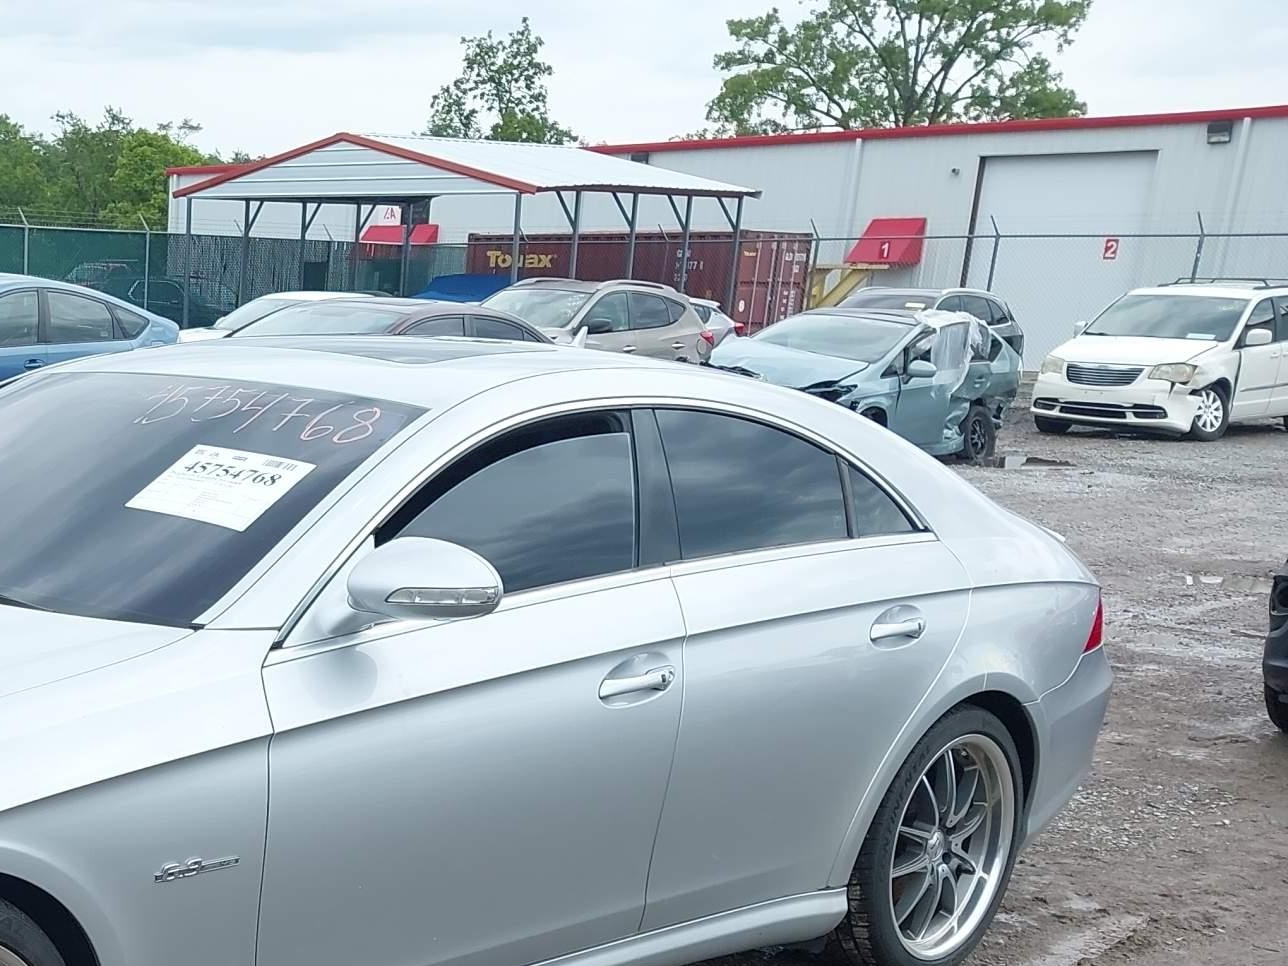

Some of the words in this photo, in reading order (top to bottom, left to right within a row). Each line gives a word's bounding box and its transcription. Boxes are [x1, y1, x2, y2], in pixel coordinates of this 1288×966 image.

[881, 242, 890, 258] 1
[1104, 242, 1118, 258] 2
[184, 460, 283, 487] 45754768
